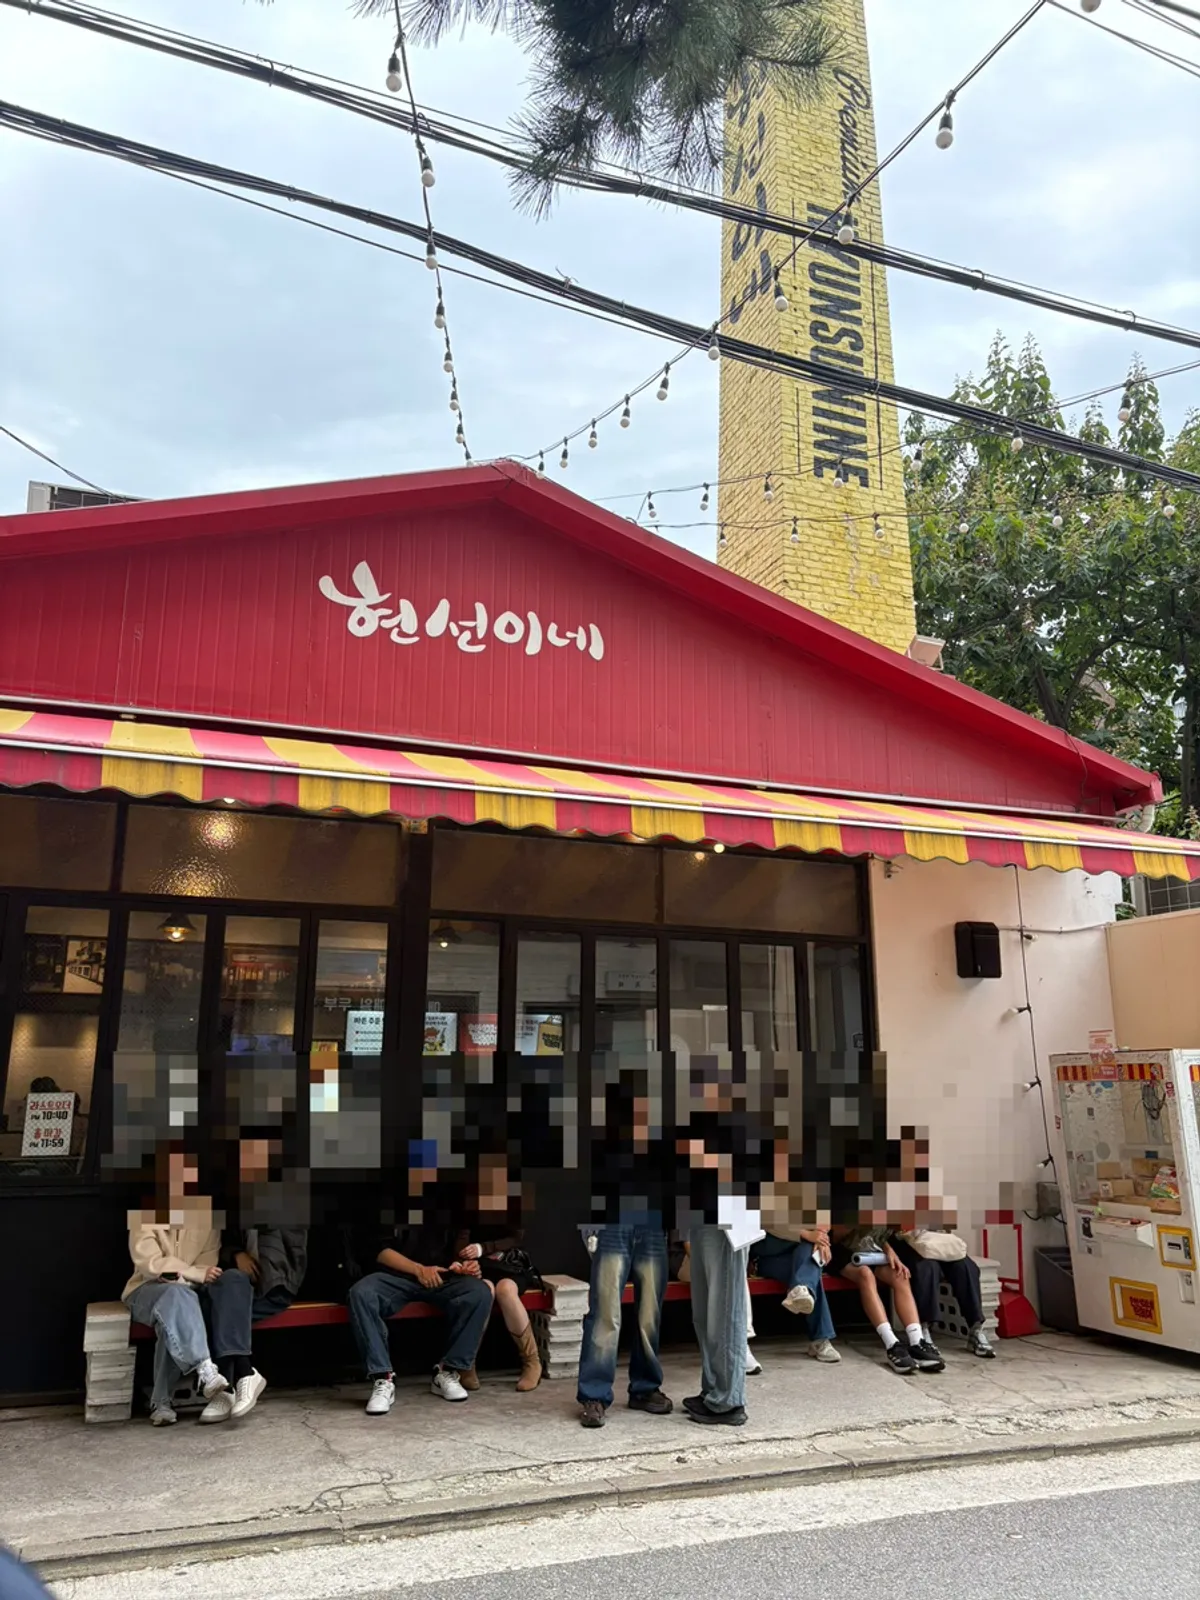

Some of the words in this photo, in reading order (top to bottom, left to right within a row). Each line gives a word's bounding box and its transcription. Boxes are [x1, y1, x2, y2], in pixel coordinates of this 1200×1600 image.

[832, 67, 872, 203] Premium
[318, 560, 604, 661] 현선이네
[30, 1101, 71, 1110] 라스트오더
[42, 1111, 68, 1120] 10:40
[44, 1128, 62, 1139] 마감
[41, 1138, 64, 1148] 11:59
